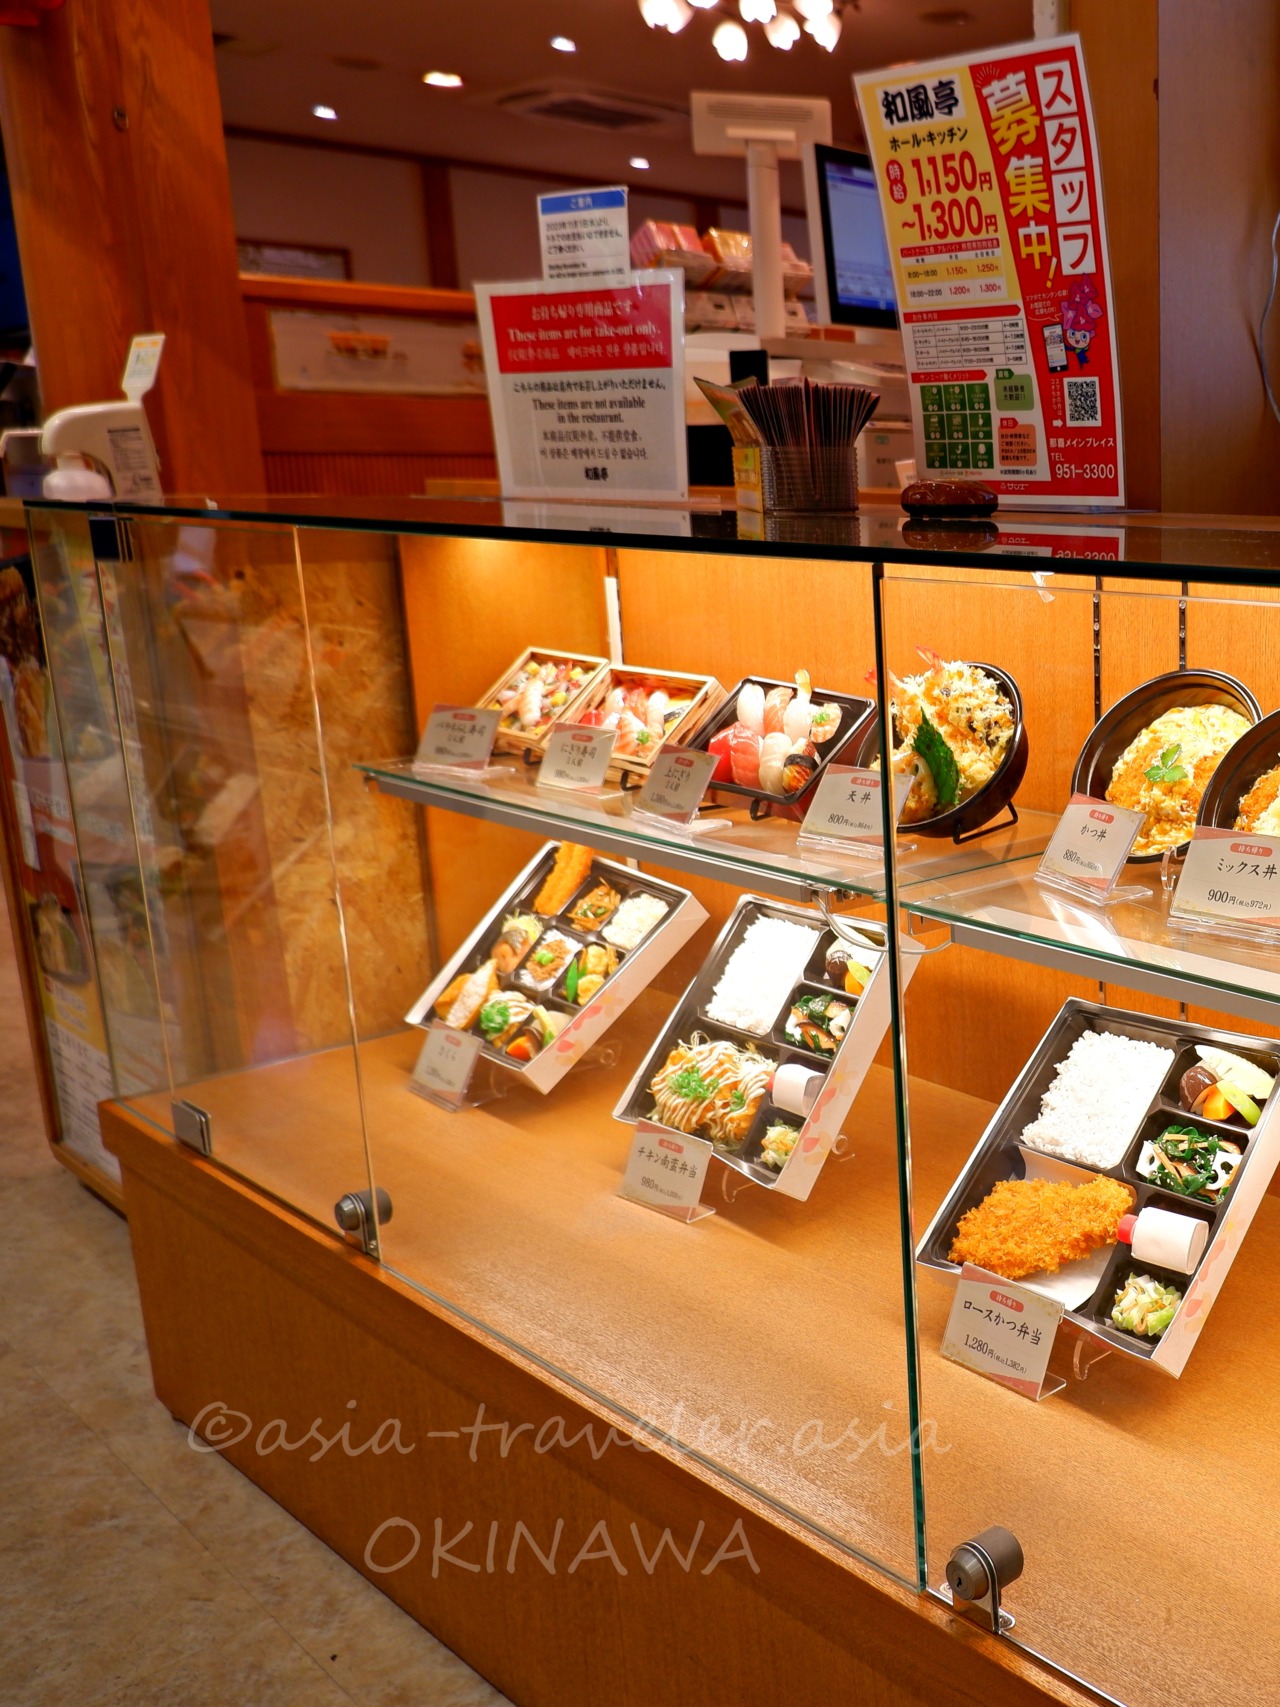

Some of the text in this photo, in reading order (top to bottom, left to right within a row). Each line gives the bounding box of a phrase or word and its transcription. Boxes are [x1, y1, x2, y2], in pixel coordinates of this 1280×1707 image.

[881, 79, 960, 126] 和風亭
[889, 126, 968, 152] ホール・キッチン
[911, 150, 993, 197] 1,150円
[1041, 68, 1090, 270] スタッフ
[888, 163, 905, 201] 時給
[507, 328, 537, 342] These
[538, 328, 563, 341] items
[564, 330, 579, 339] are
[580, 325, 593, 338] for
[595, 323, 633, 337] take-out
[532, 397, 646, 411] These items are not available
[557, 412, 624, 423] in the restaurant.
[1051, 453, 1065, 462] TEL
[1055, 463, 1115, 479] 951-3300
[1217, 858, 1278, 880] ミックス丼
[1207, 888, 1272, 911] 900円(税込972円)
[963, 1300, 1043, 1346] ロースかつ弁当
